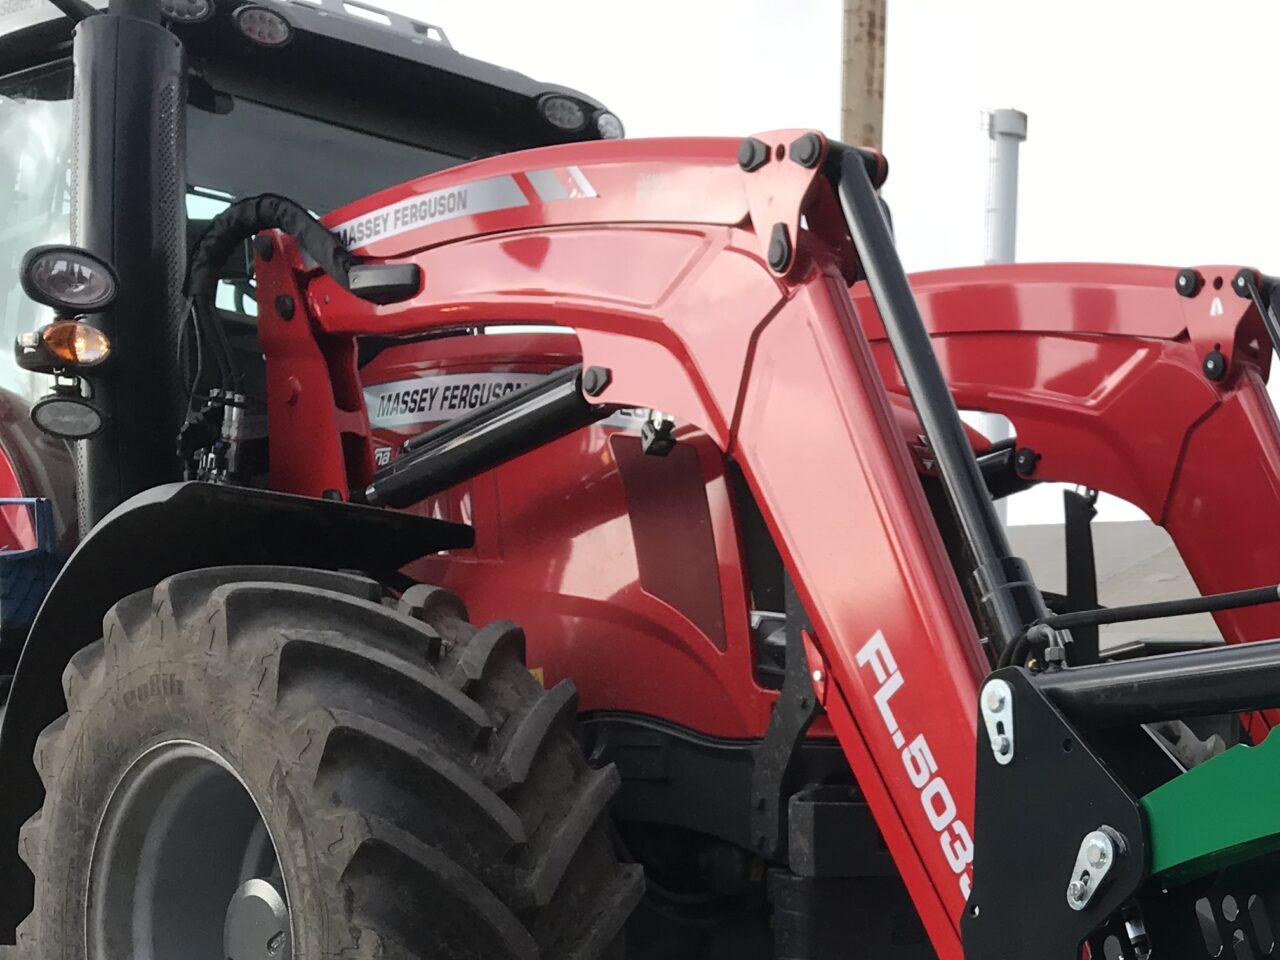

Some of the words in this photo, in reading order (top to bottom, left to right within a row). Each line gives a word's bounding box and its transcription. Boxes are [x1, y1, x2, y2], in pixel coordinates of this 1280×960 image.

[338, 212, 390, 247] MASSEY
[393, 189, 468, 229] FERGUSON
[377, 387, 438, 417] MASSEY
[440, 382, 528, 411] FERGUS
